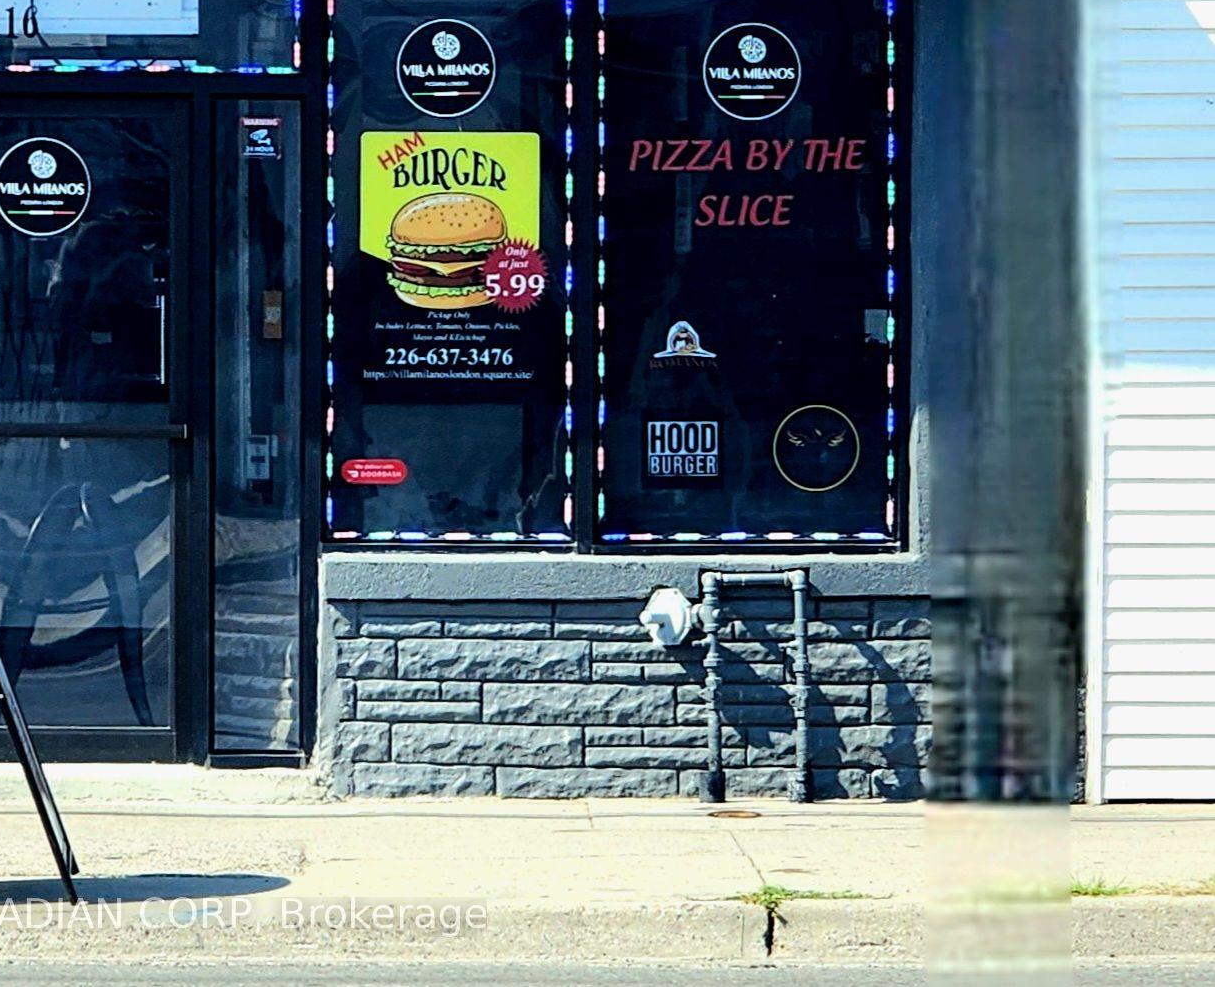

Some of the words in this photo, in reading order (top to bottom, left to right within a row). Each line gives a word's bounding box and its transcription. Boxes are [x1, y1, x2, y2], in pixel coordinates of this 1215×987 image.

[401, 63, 436, 78] VILLA
[436, 62, 491, 77] MILANOS
[708, 67, 741, 81] VILLA
[742, 67, 796, 80] MILANOS
[377, 131, 427, 171] HAM
[629, 138, 734, 173] PIZZA
[745, 138, 796, 172] BY
[802, 135, 867, 173] THE
[392, 147, 508, 192] BURGER
[32, 181, 86, 196] MILANOS
[694, 194, 796, 227] SLICE
[504, 246, 530, 259] Only
[484, 273, 546, 298] 5.99
[385, 347, 514, 366] 226-637-3476
[649, 422, 718, 454] HOOD
[650, 455, 718, 475] BURGER
